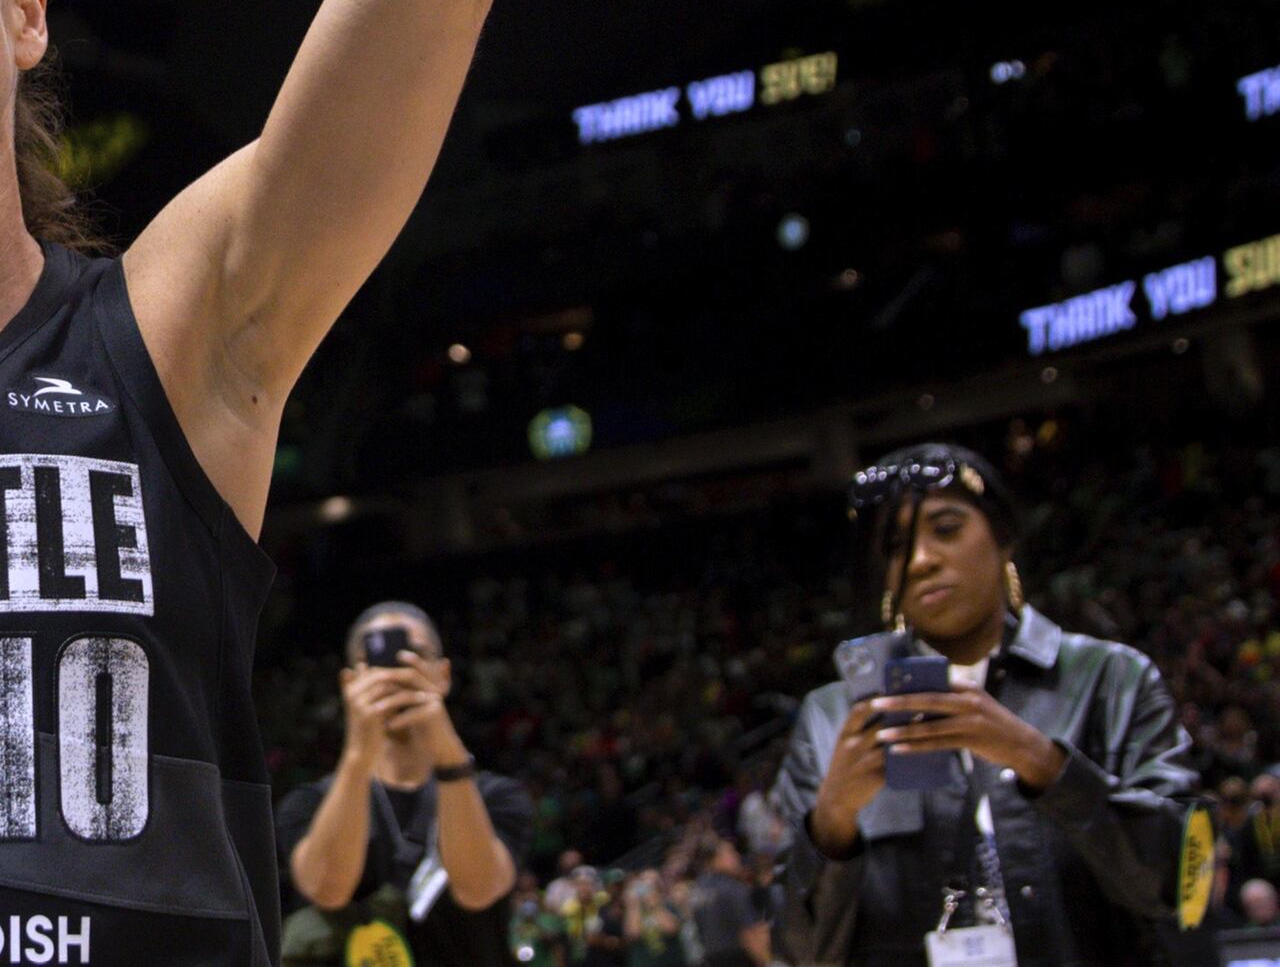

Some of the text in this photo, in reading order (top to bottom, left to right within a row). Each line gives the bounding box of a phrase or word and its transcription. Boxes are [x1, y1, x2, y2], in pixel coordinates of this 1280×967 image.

[687, 69, 755, 120] YOU
[1019, 279, 1137, 356] THANK
[1144, 254, 1217, 321] YOU
[7, 392, 110, 414] SYMETRA
